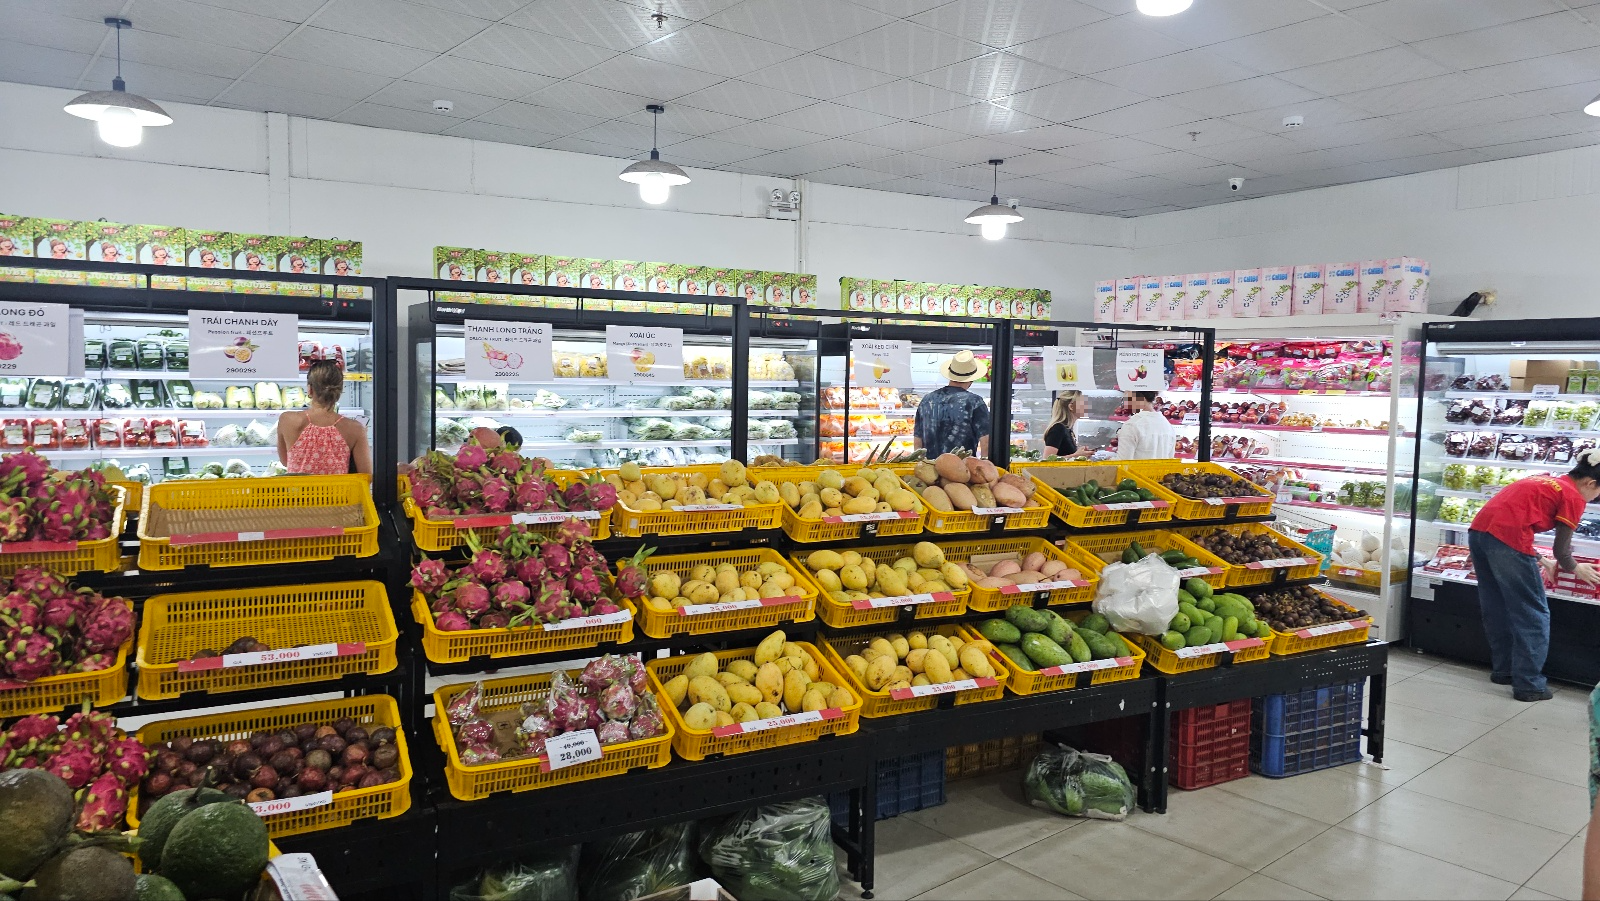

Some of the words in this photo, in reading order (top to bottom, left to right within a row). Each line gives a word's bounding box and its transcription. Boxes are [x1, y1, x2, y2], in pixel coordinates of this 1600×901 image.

[201, 316, 222, 325] TRÁI
[261, 652, 300, 661] 53.000
[560, 747, 592, 761] 28,000
[252, 802, 291, 813] 3.000
